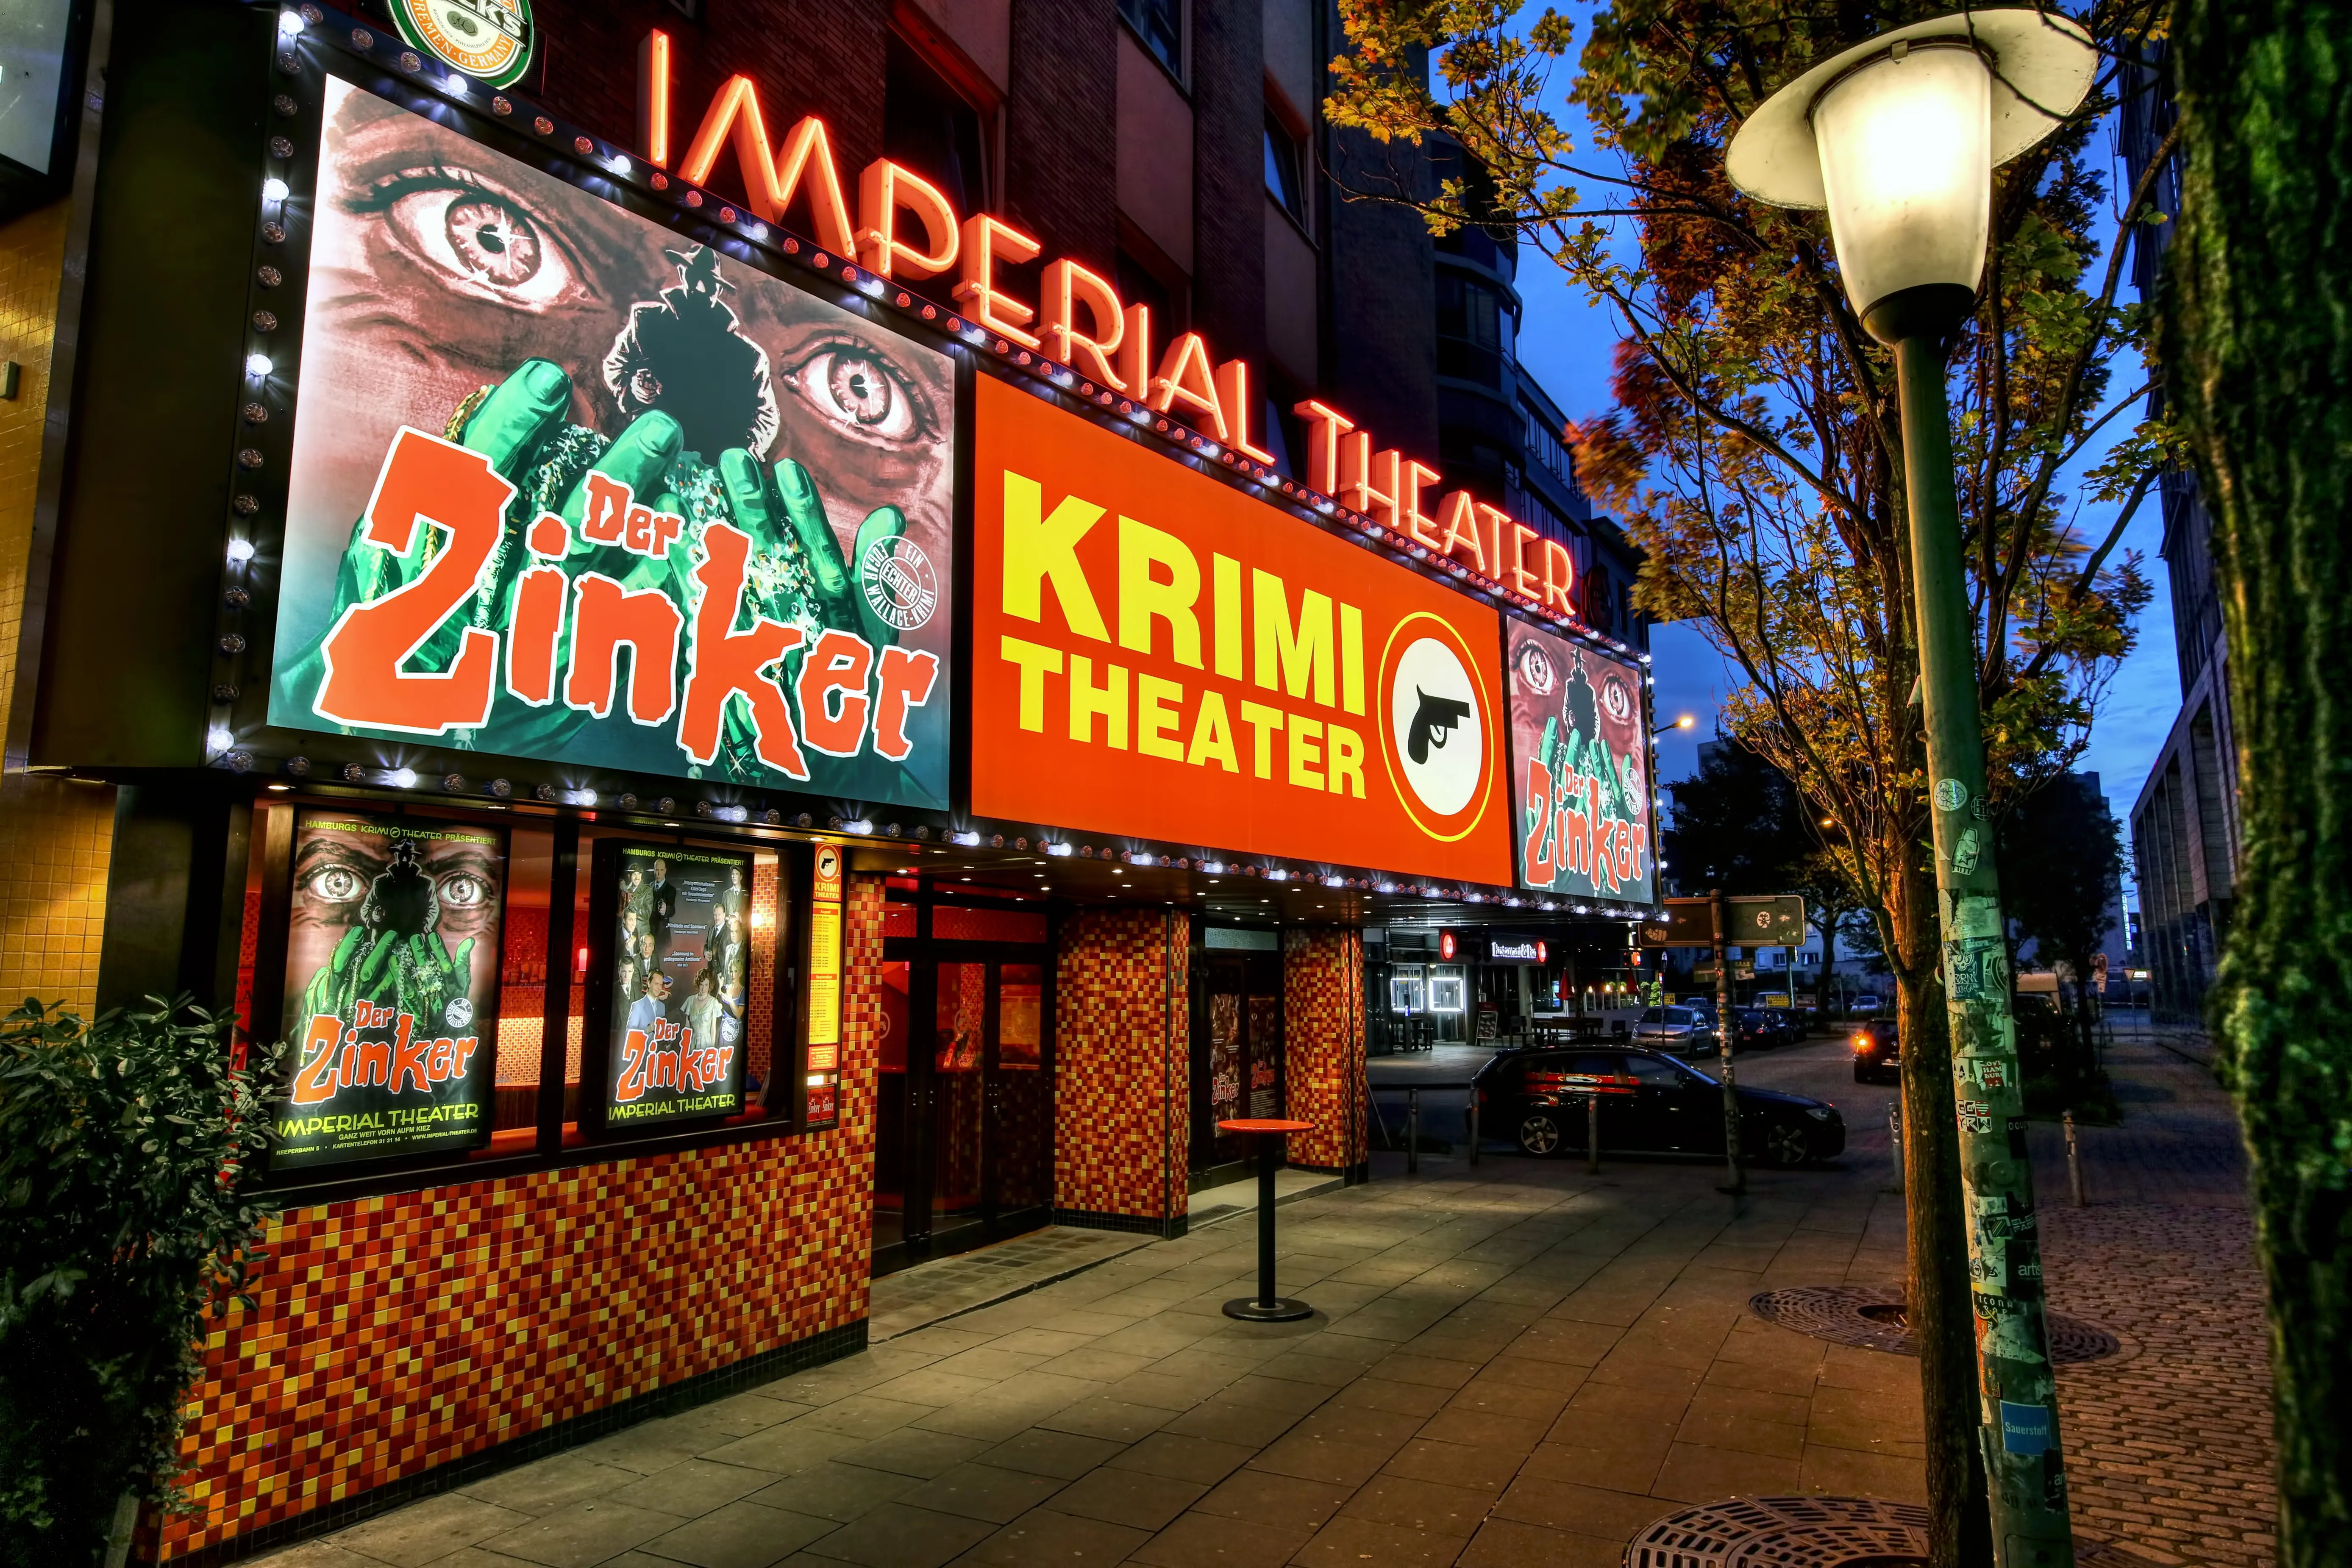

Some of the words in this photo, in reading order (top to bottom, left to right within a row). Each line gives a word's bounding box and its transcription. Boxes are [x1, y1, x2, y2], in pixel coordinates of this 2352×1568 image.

[411, 0, 453, 55] REMEN
[459, 35, 511, 67] GERMANY
[637, 28, 1275, 467] IMPERIAL
[1294, 399, 1576, 617] THEATER
[584, 470, 685, 559] Der
[864, 542, 889, 581] EDGAR
[905, 544, 924, 569] EIN
[882, 562, 920, 603] ECHTER
[1003, 469, 1365, 717] KRIMI
[313, 425, 940, 783] Zinker
[867, 583, 934, 627] WALLACE-KRIMI
[1001, 635, 1367, 800] THEATER
[1563, 761, 1585, 798] Der
[306, 820, 357, 832] HAMBURGS
[361, 825, 388, 835] KRIMI
[401, 829, 442, 840] THEATER
[445, 833, 497, 845] PRÄSENTIERT
[1524, 756, 1646, 895] Zinker
[623, 848, 656, 857] HAMBURGS
[657, 851, 675, 860] KRIMI
[683, 854, 709, 863] THEATER
[711, 856, 745, 866] PRÄSENTIERT
[815, 881, 840, 893] KRIMI
[815, 891, 839, 899] THEATER
[354, 999, 395, 1029] Der
[655, 1017, 680, 1041] Der
[291, 1013, 479, 1105] Zinker
[615, 1028, 734, 1102] Zinker
[609, 1104, 675, 1121] IMPERIAL
[677, 1093, 735, 1112] THEATER
[1212, 1076, 1239, 1105] Zinker
[278, 1112, 385, 1138] IMPERIAL
[388, 1103, 478, 1126] THEATER
[339, 1132, 358, 1140] GANZ
[359, 1130, 376, 1138] WEIT
[378, 1128, 396, 1136] VORN
[397, 1126, 415, 1134] AUFM
[276, 1146, 315, 1155] REEPERBAHN
[332, 1140, 378, 1149] KARTENTELEFON
[411, 1128, 478, 1140] WWW.IMPERIAL-THEATER.DE
[2005, 1422, 2047, 1436] Sauerstoff
